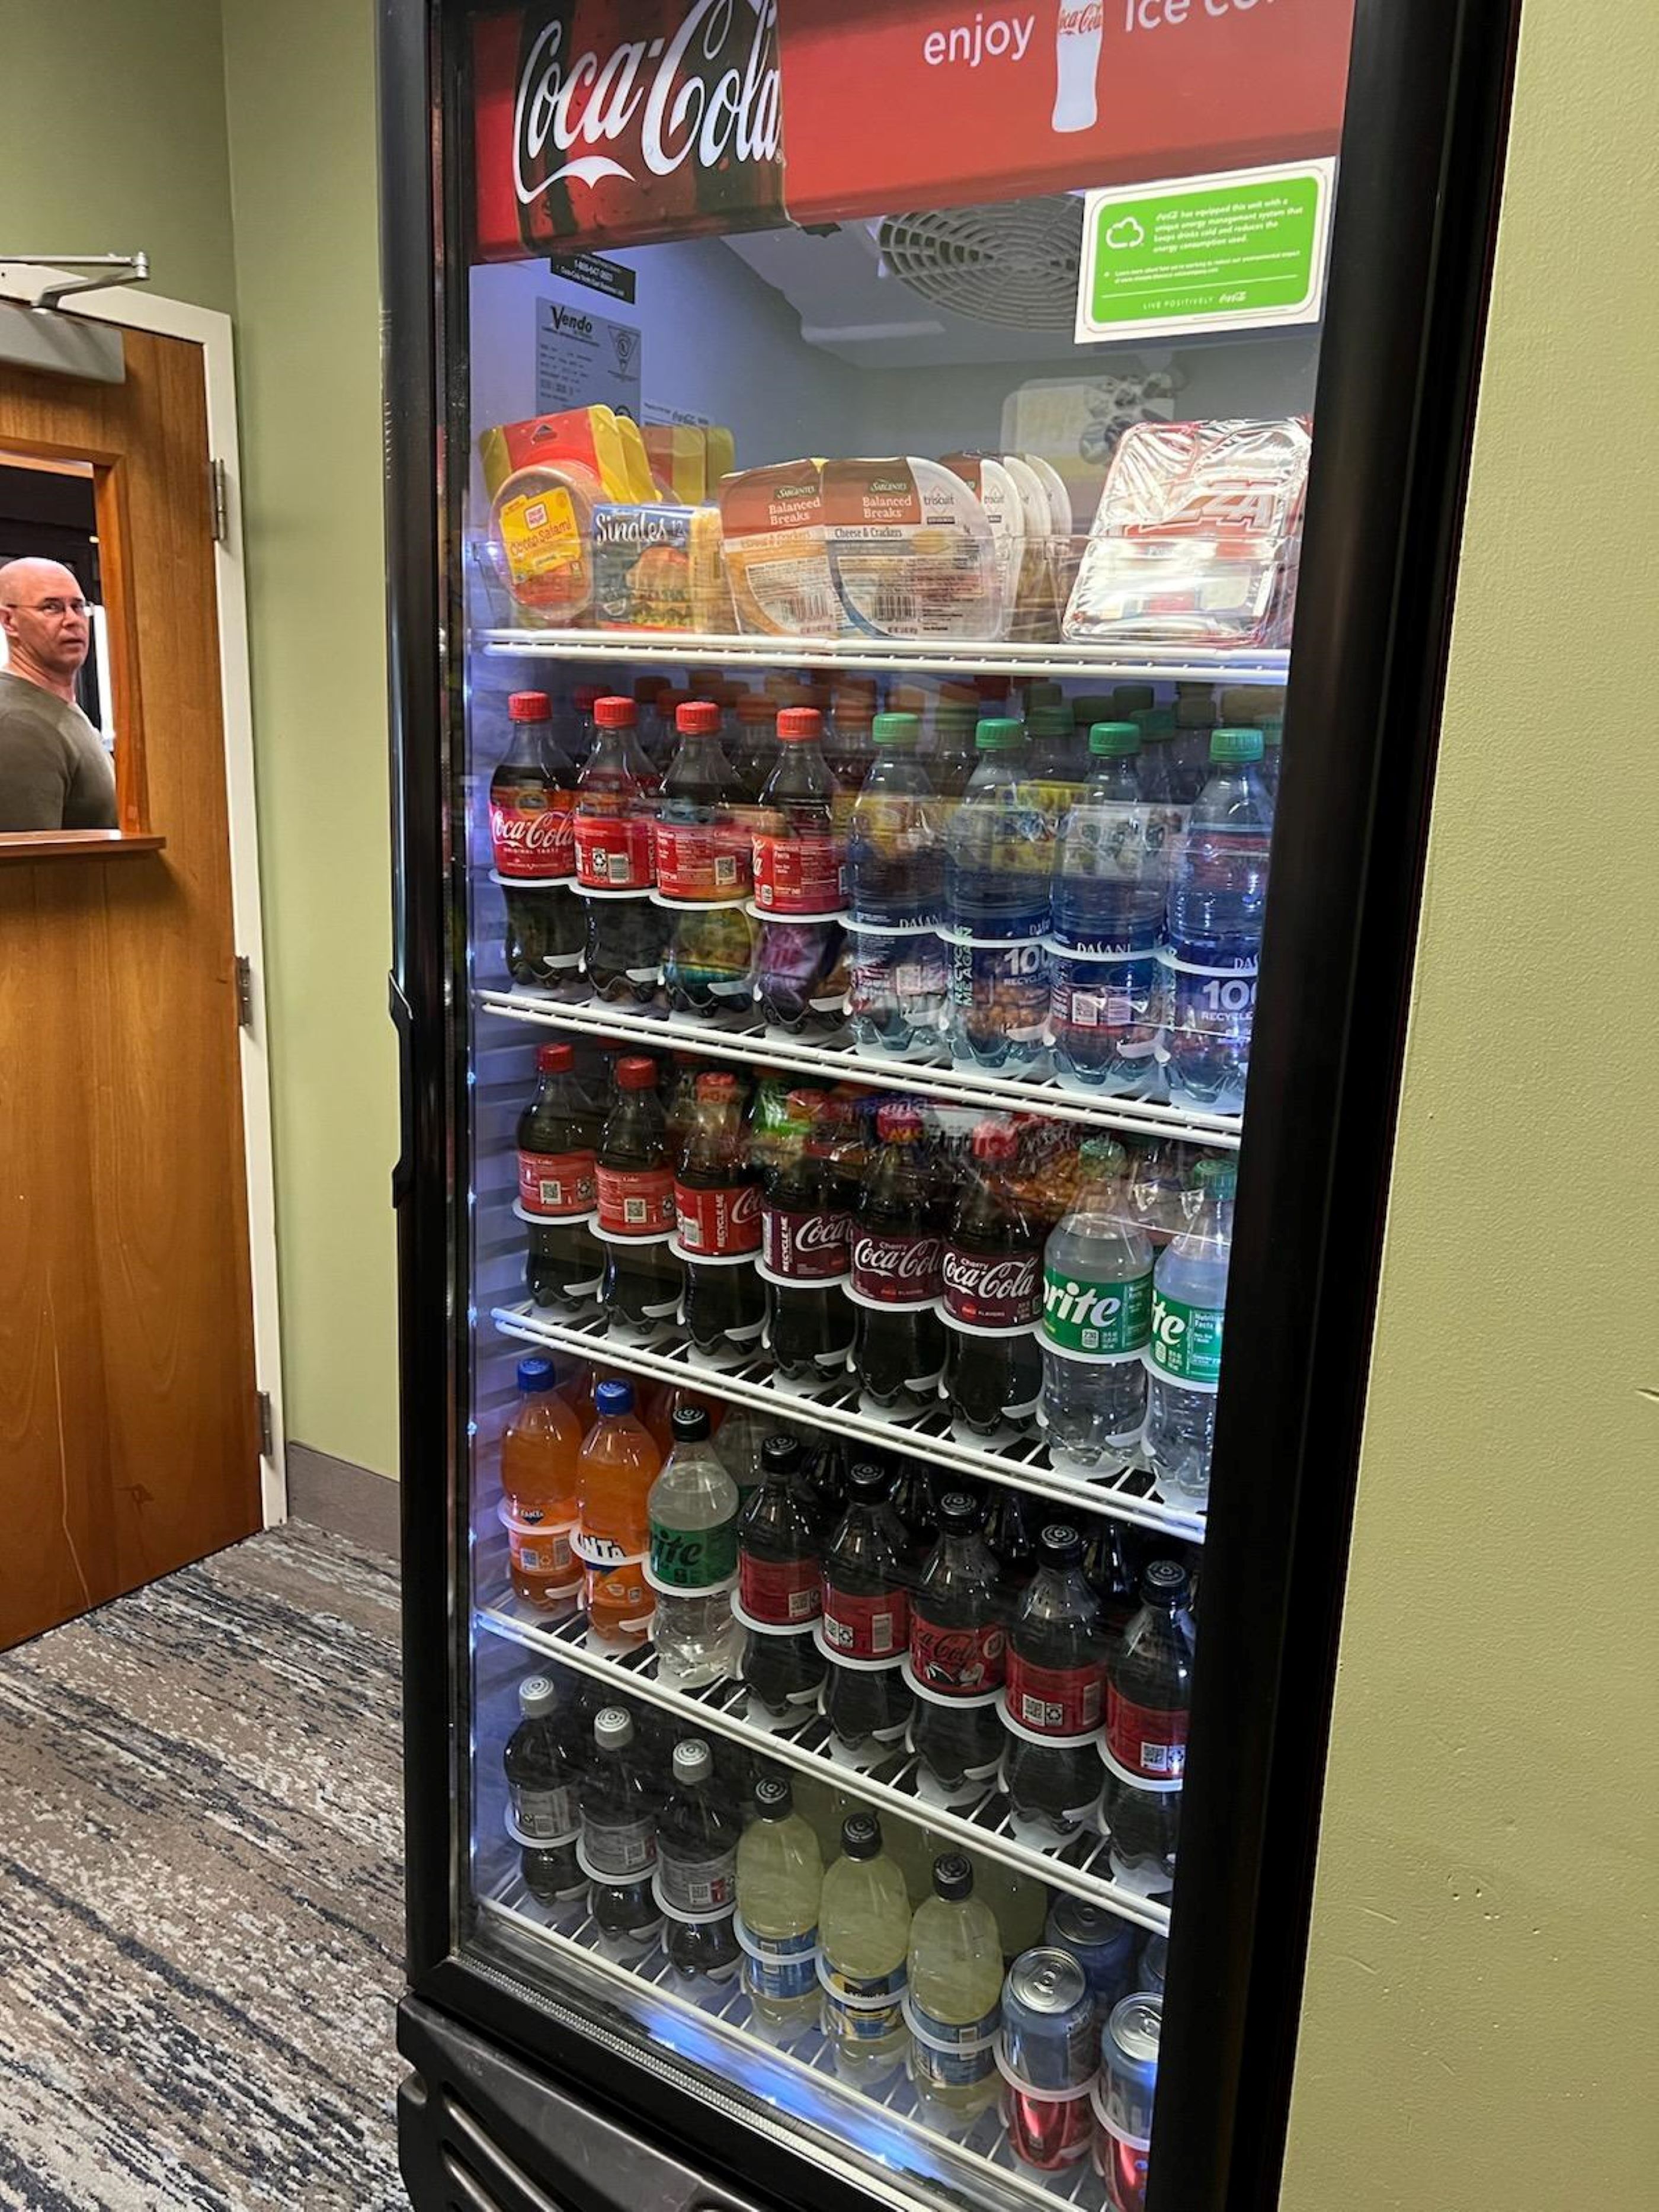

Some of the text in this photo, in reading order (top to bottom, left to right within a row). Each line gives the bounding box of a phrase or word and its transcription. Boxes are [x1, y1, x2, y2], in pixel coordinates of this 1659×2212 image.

[923, 12, 1036, 67] enjoy
[512, 0, 782, 204] Coca-Cola
[550, 305, 592, 331] Vendo
[768, 497, 821, 514] Balanced
[862, 496, 912, 507] Balanced
[863, 507, 903, 518] Breaks
[596, 510, 667, 554] Singles
[770, 511, 811, 526] Breaks
[834, 529, 861, 538] Cheese
[870, 527, 903, 538] Crackers
[492, 811, 574, 849] Coca-Cola
[953, 924, 963, 1006] RECYCE
[942, 1251, 1039, 1299] Coca-Cola
